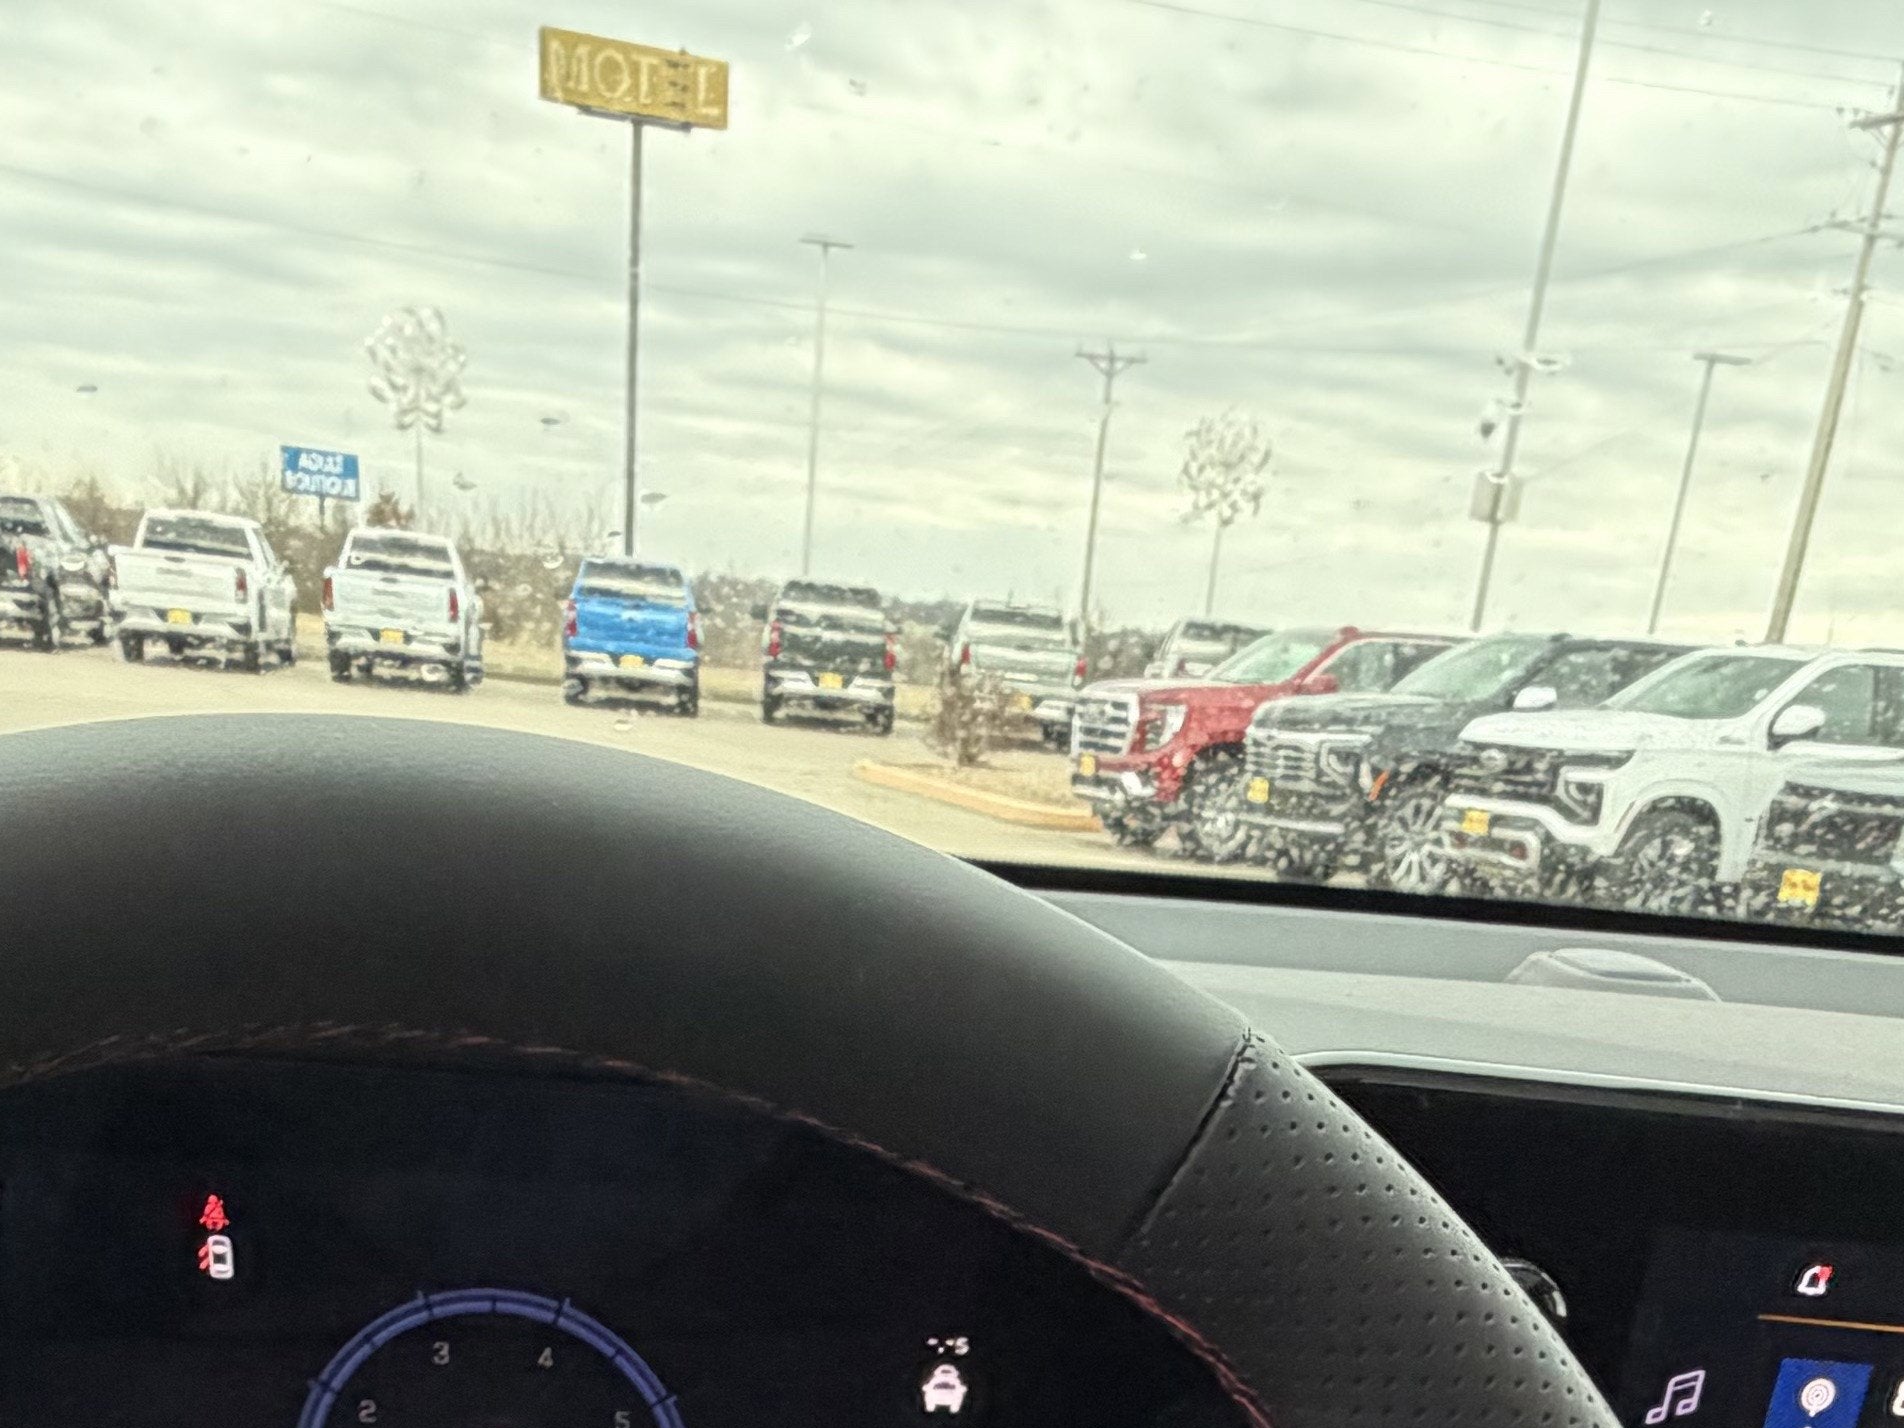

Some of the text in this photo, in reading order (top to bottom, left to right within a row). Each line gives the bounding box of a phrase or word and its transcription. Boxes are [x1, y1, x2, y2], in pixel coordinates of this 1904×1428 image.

[433, 1341, 450, 1366] 3
[537, 1347, 554, 1369] 4
[358, 1399, 377, 1423] 2
